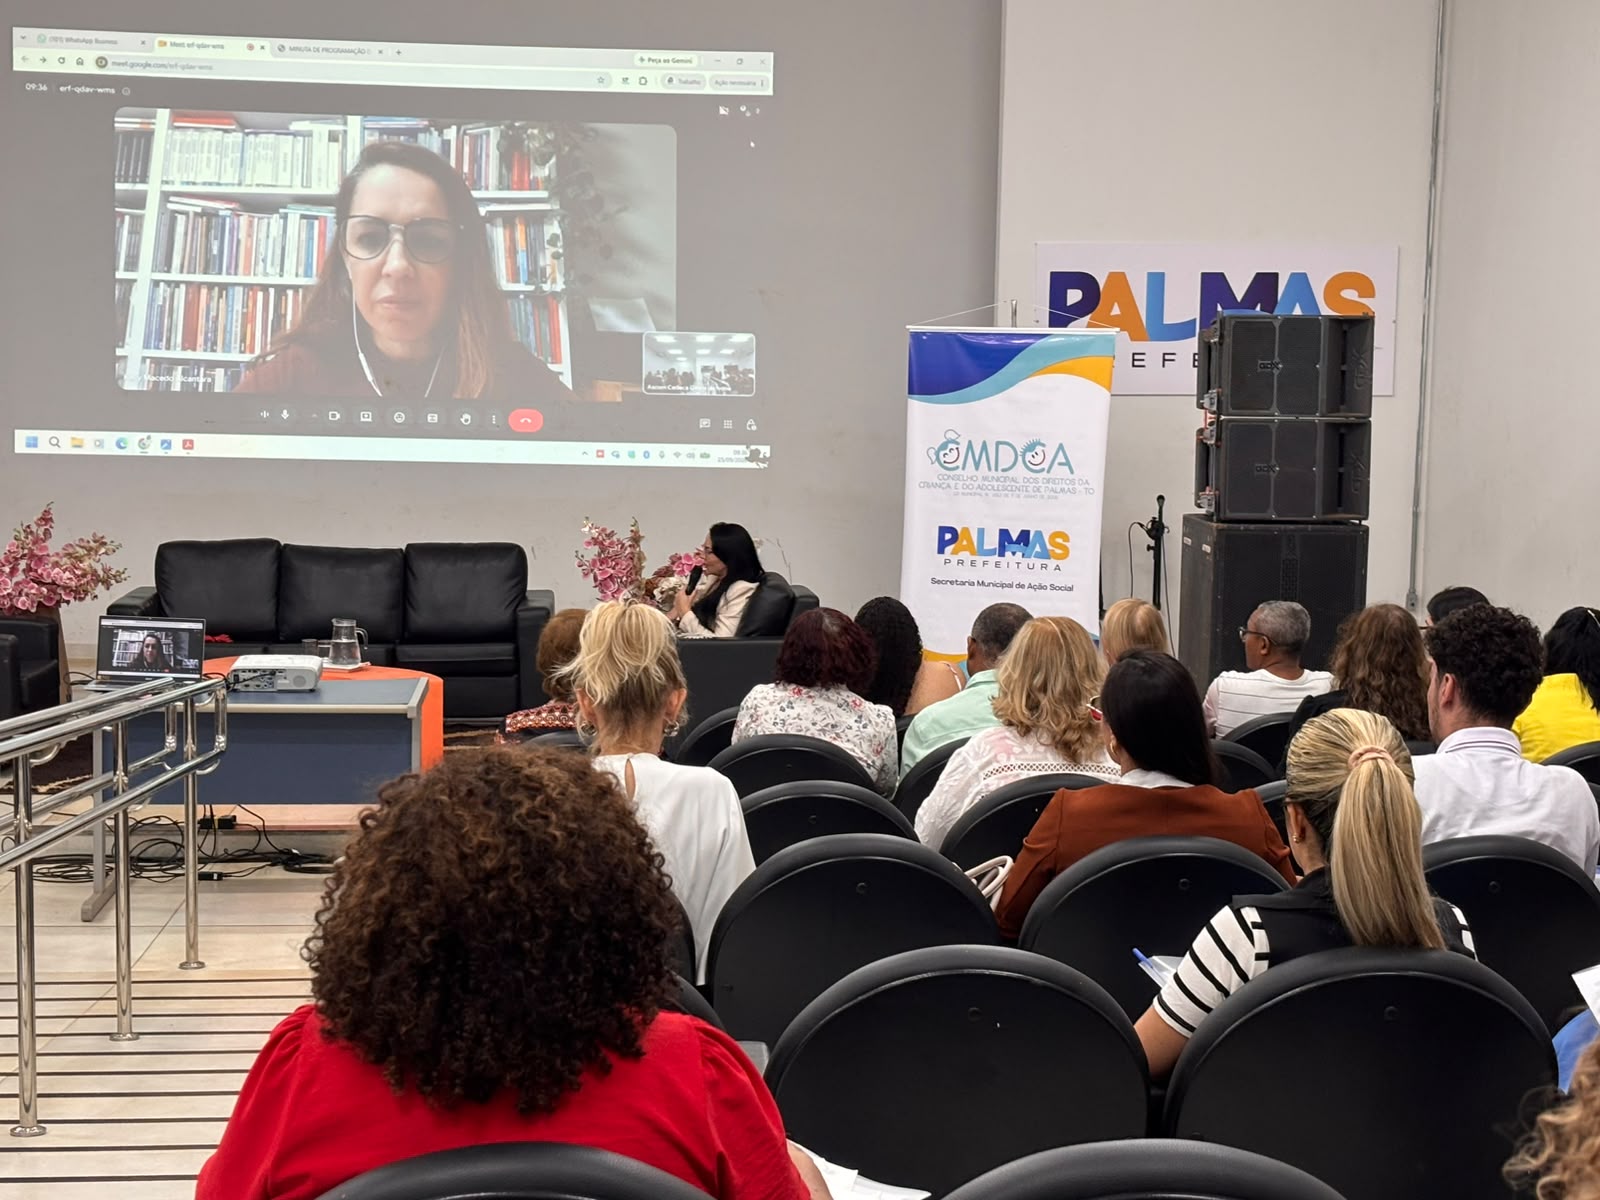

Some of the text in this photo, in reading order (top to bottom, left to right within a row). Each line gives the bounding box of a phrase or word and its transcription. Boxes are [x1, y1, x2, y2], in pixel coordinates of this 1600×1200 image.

[25, 82, 48, 91] 09:36
[59, 85, 116, 94] erf-qdav-wms
[1048, 270, 1376, 342] PALMAS
[935, 438, 1075, 475] CMDCA
[937, 473, 1090, 486] CONSELHO MUNICIPAL DOS DIREITOS DA
[918, 481, 952, 490] CRIANÇA
[976, 484, 1030, 493] ADOLESCENTE
[1032, 485, 1041, 493] DE
[1044, 486, 1077, 495] PALMAS
[936, 526, 1070, 561] PALMAS
[944, 558, 1062, 572] PREFEITURA
[931, 577, 1074, 592] Secretaria Municipal de Ação Social
